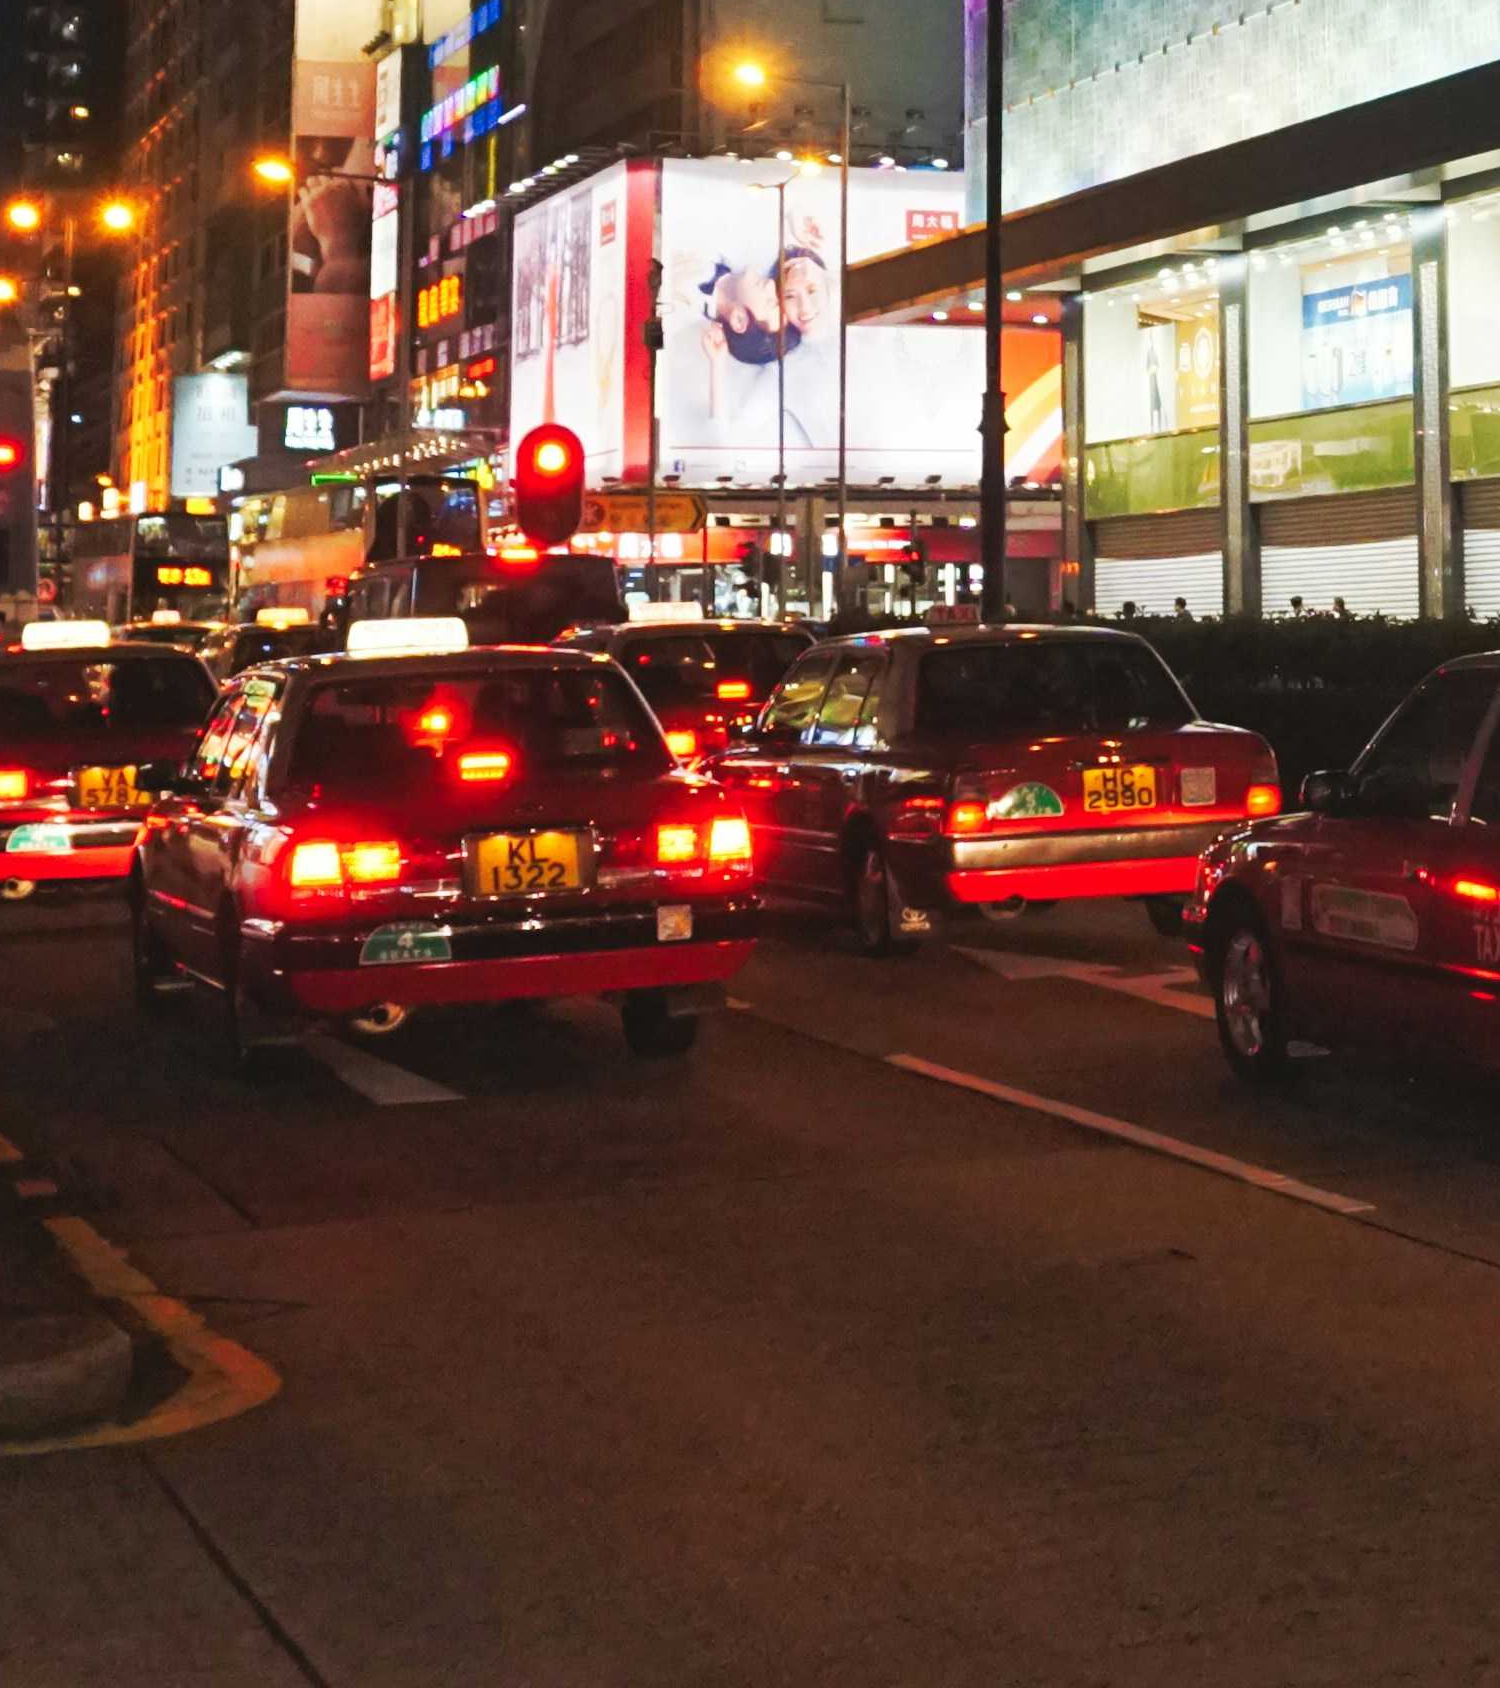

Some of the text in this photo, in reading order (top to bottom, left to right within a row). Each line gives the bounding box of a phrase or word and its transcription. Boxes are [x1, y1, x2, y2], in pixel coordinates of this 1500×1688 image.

[101, 769, 129, 788] VA
[1102, 769, 1135, 791] HC
[507, 838, 549, 865] KL
[492, 862, 567, 891] 1322
